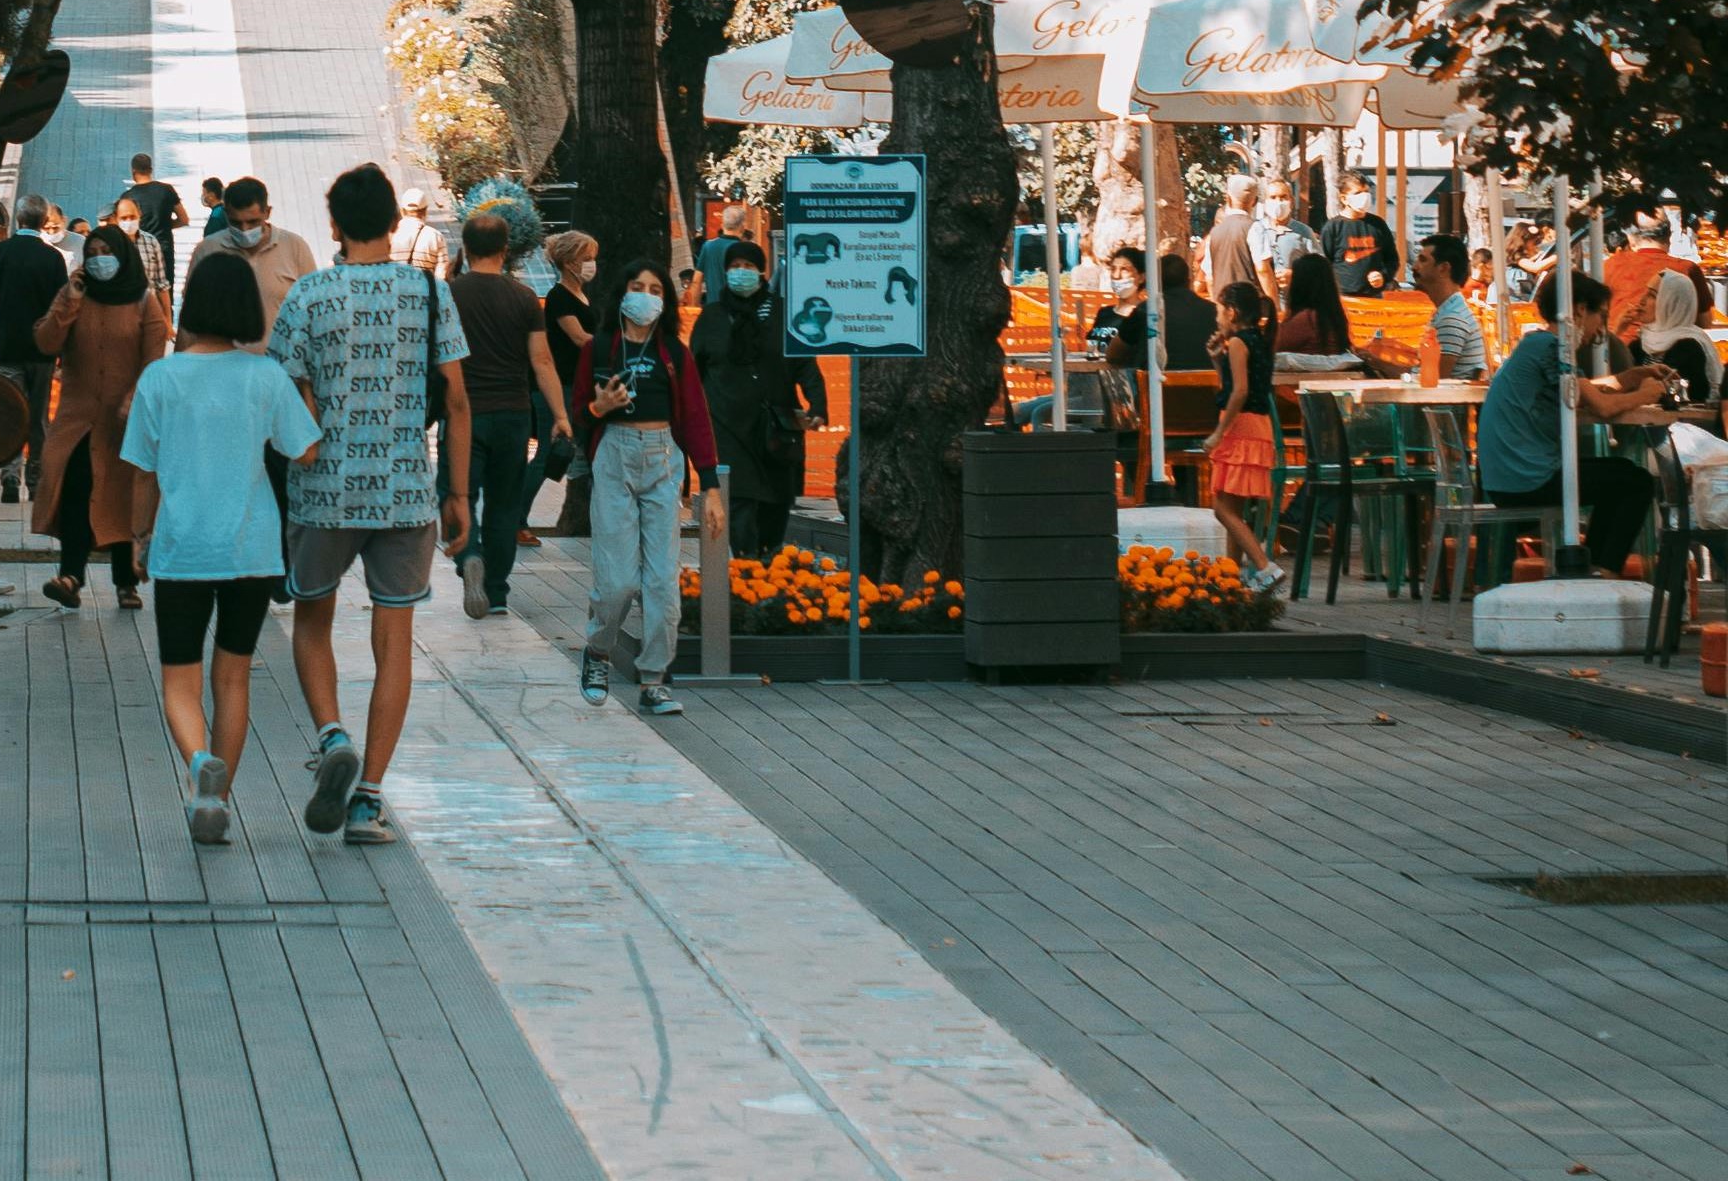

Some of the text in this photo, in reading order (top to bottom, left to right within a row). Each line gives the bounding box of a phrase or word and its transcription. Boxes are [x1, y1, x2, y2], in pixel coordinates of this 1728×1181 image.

[739, 70, 836, 116] Gelateria
[1000, 83, 1085, 109] teria
[300, 269, 344, 292] STAY
[350, 279, 394, 294] STAY
[307, 296, 348, 319] STAY
[353, 310, 397, 327] STAY
[351, 343, 396, 360] STAY
[350, 376, 395, 393] STAY
[349, 410, 393, 425] STAY
[346, 443, 391, 458] STAY
[344, 475, 390, 491] STAY
[302, 490, 341, 507] STAY
[343, 505, 391, 520] STAY
